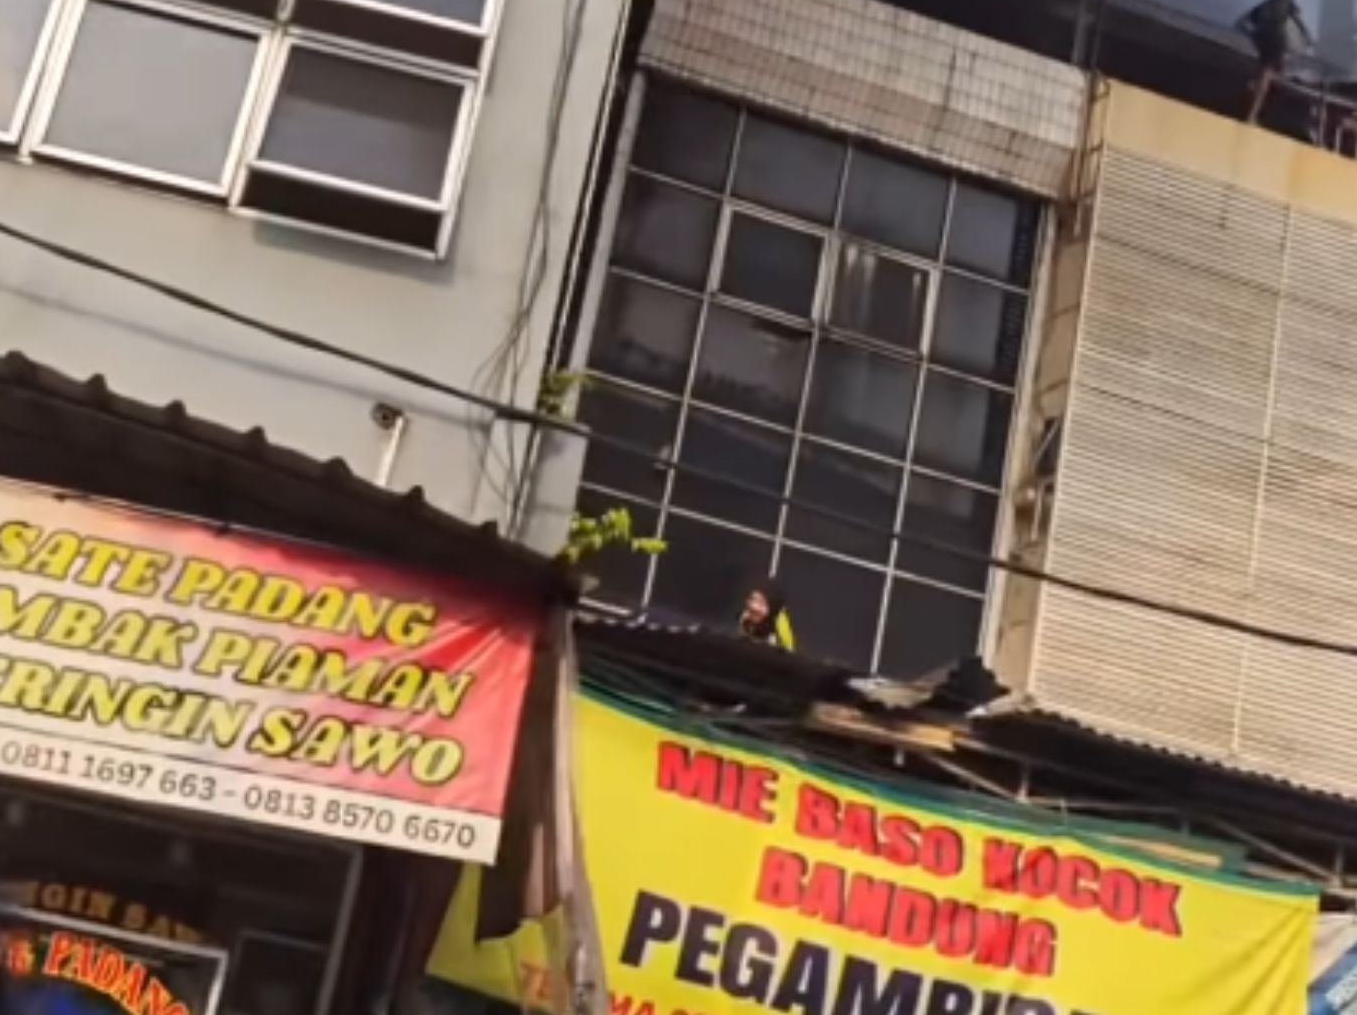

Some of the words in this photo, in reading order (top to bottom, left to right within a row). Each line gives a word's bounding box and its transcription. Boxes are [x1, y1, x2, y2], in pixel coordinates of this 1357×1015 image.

[168, 557, 438, 647] PADANG
[193, 625, 474, 720] PIAMAN
[1, 739, 71, 774] 0811
[81, 751, 153, 790] 1697
[159, 769, 217, 802] 663
[243, 781, 316, 823] 0813
[323, 796, 395, 836] 8570
[403, 809, 476, 849] 6670
[245, 708, 465, 786] SAWO
[655, 739, 780, 825] MIE
[794, 783, 964, 877] BASO
[981, 837, 1183, 937] KOCOK
[755, 846, 1058, 978] BANDUNG
